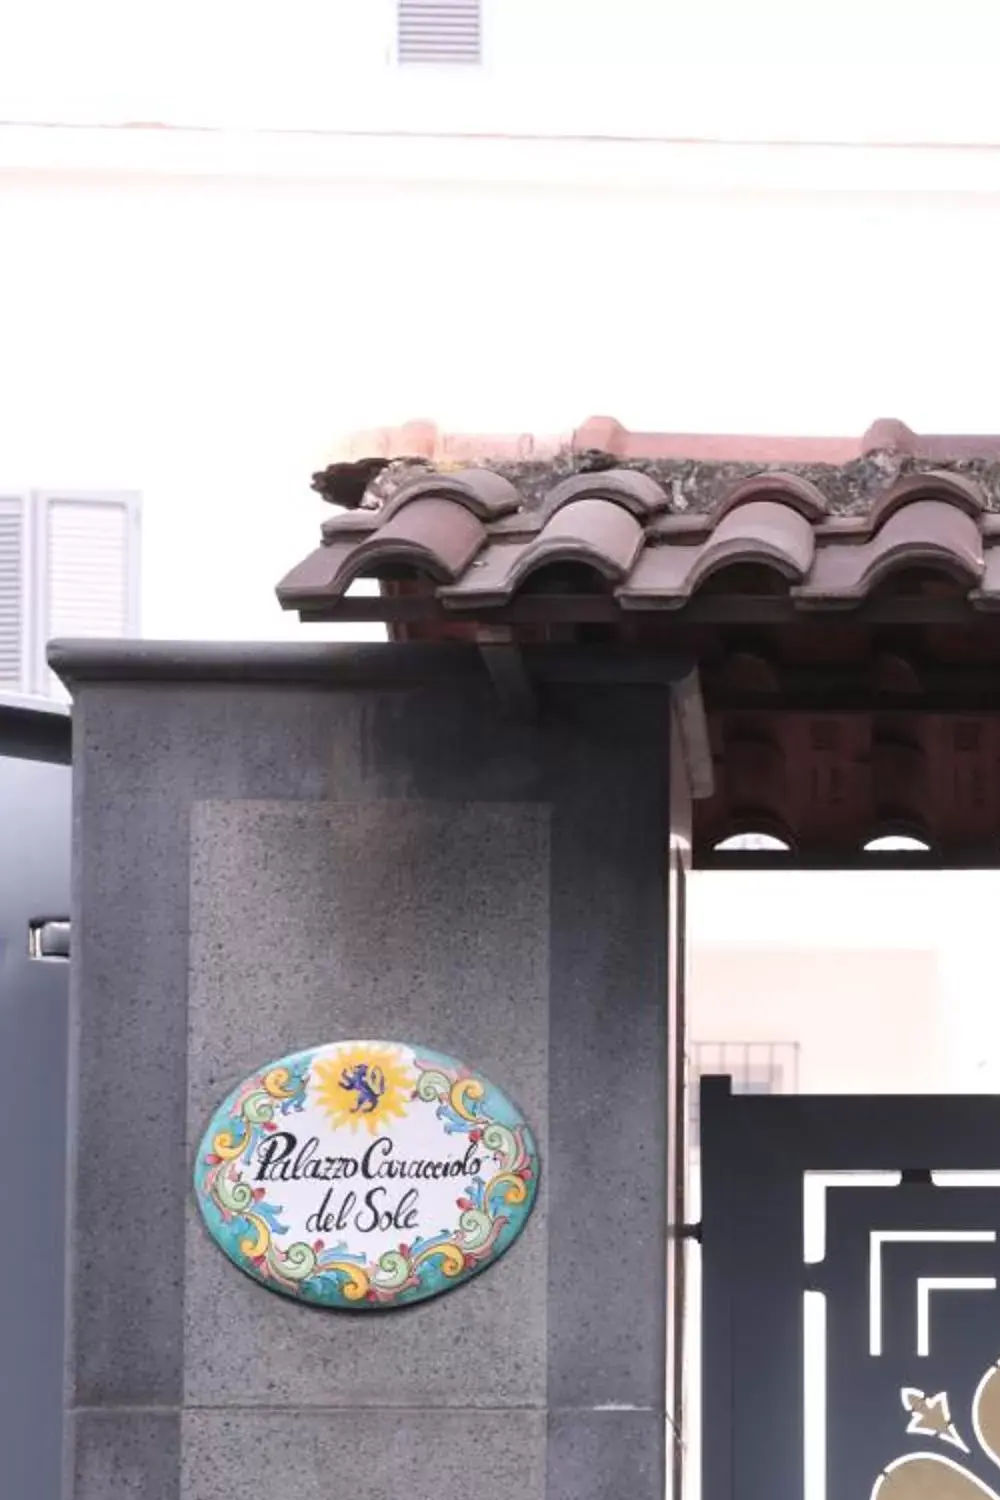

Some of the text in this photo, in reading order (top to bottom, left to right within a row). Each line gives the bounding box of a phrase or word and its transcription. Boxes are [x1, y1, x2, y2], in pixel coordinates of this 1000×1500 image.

[254, 1131, 482, 1182] Palazzo Caracciolo
[305, 1187, 420, 1234] del Sole
